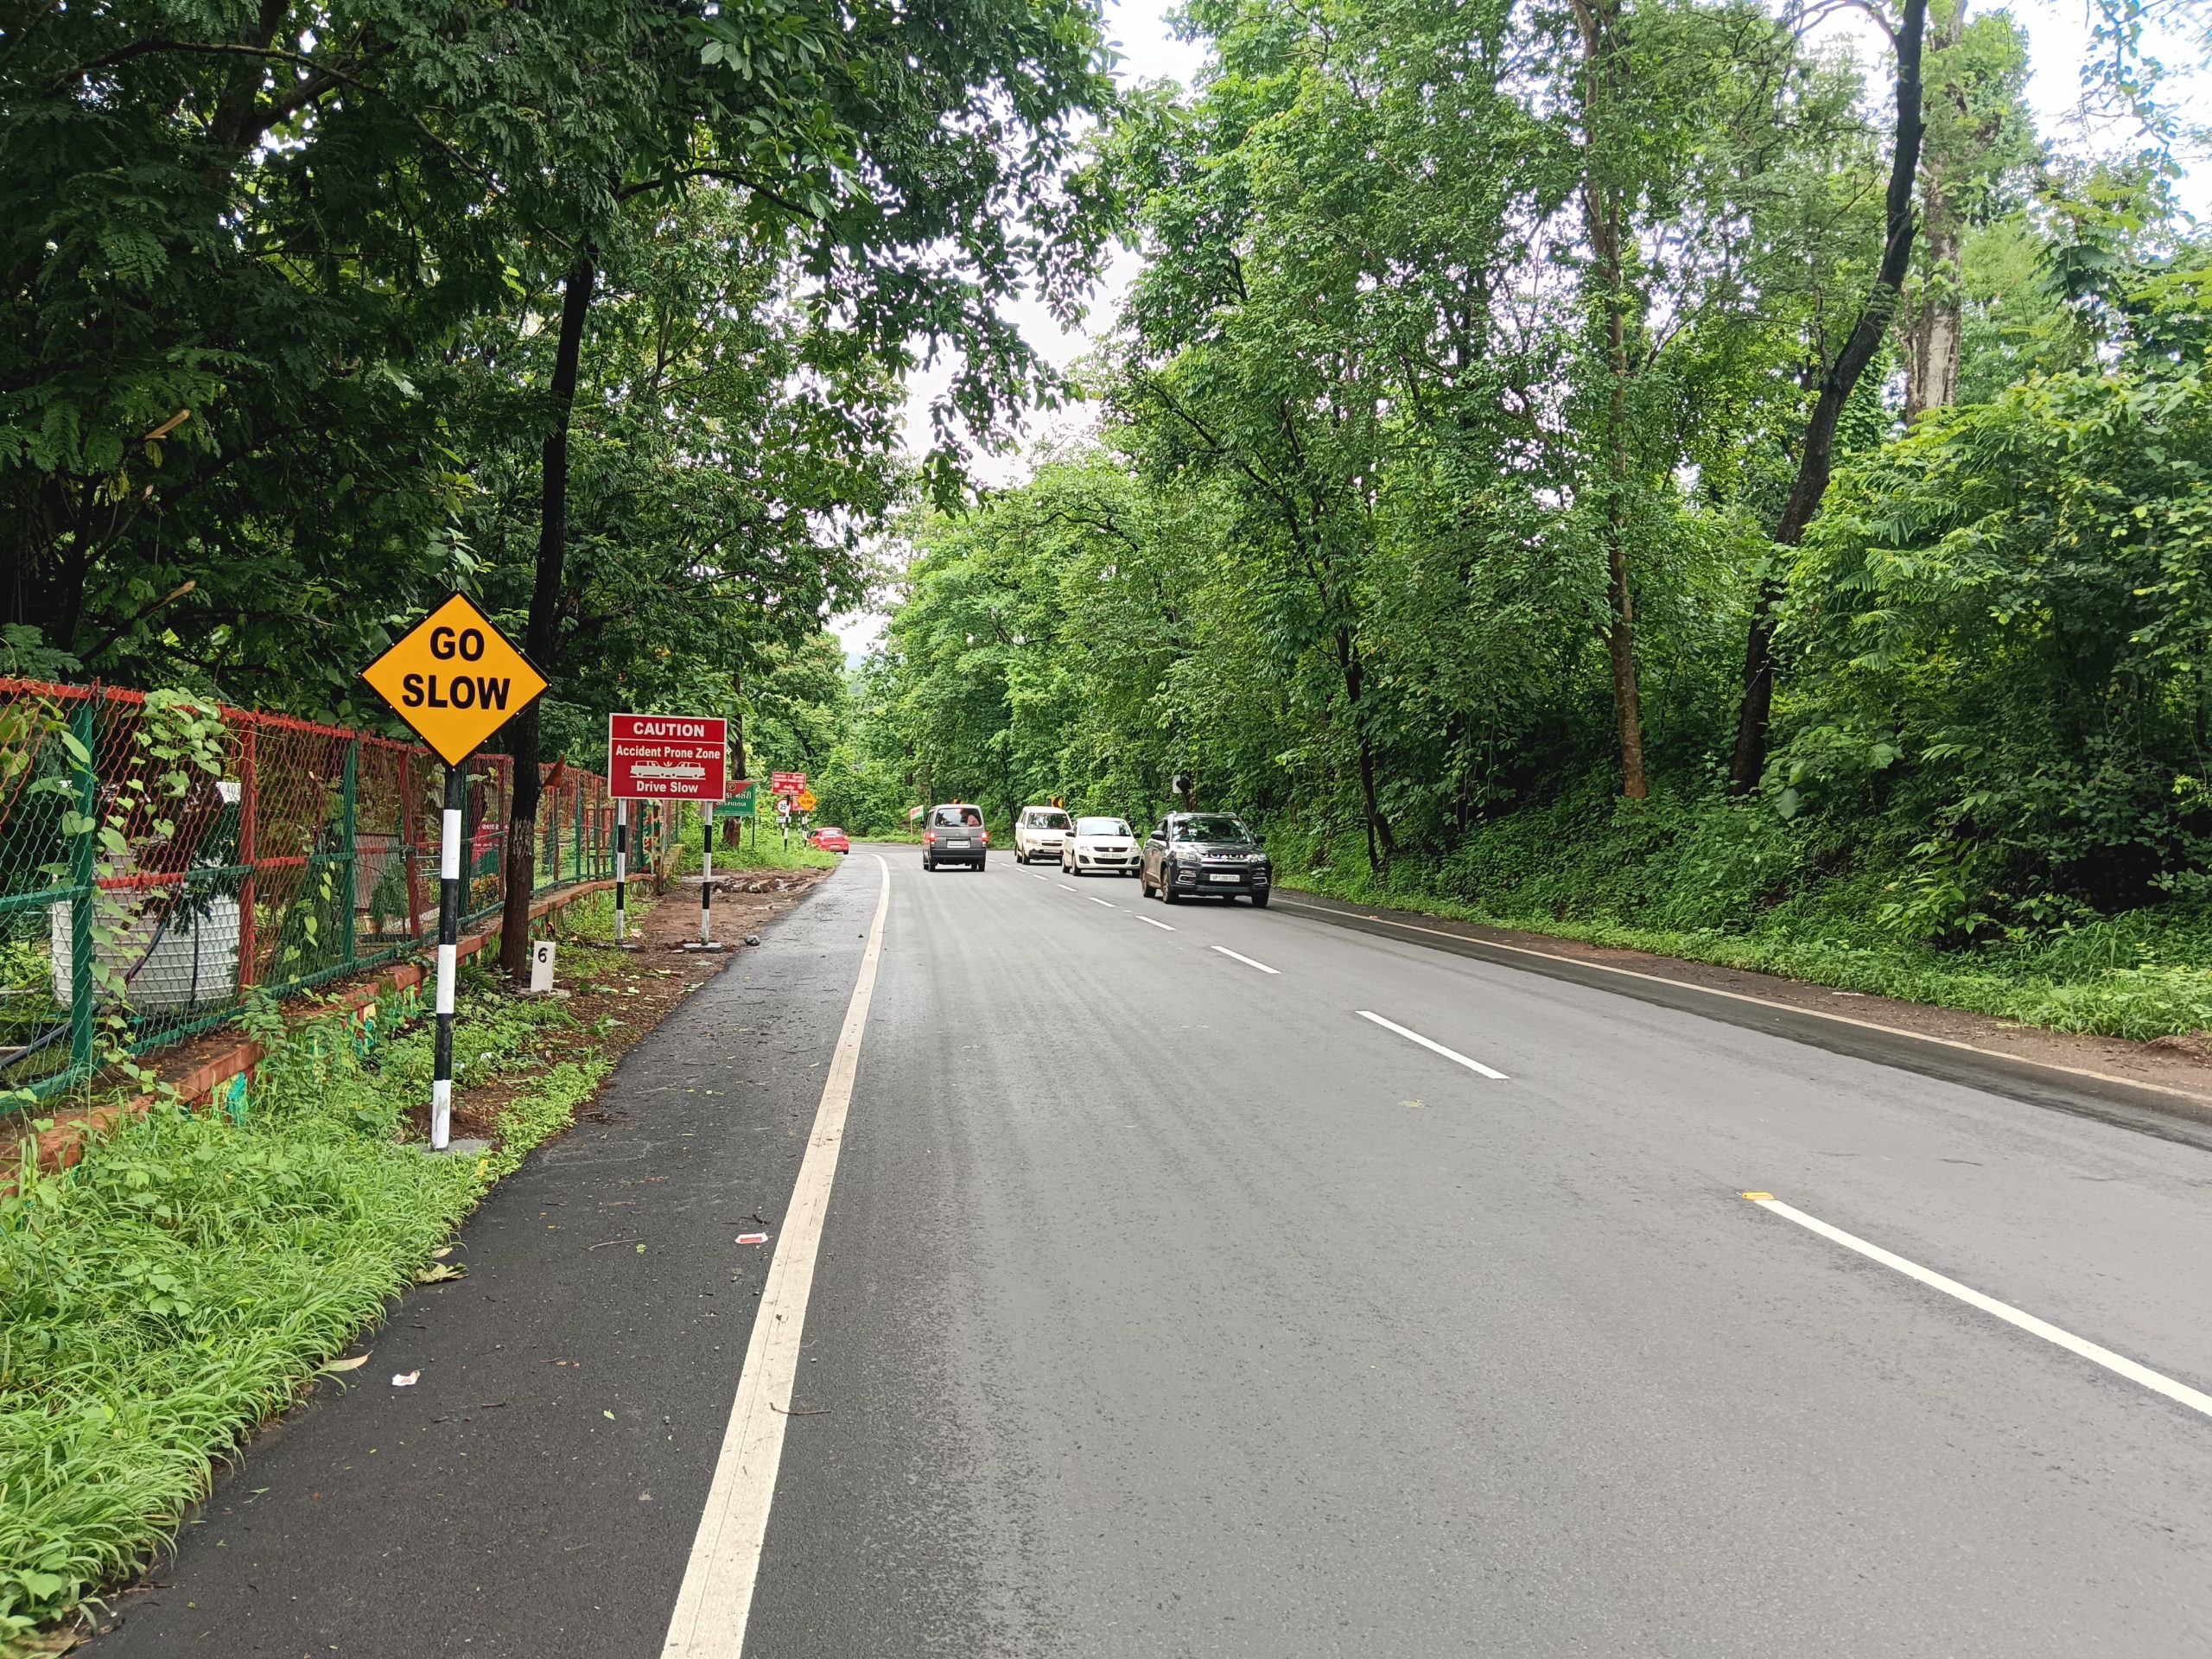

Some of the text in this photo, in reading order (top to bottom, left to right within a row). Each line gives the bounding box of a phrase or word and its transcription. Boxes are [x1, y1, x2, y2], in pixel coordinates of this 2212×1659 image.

[430, 626, 485, 661] GO
[402, 673, 511, 710] SLOW
[632, 721, 705, 737] CAUTION
[615, 745, 721, 760] Accident Prone Zone
[636, 780, 698, 793] Drive Slow
[537, 947, 548, 963] 6
